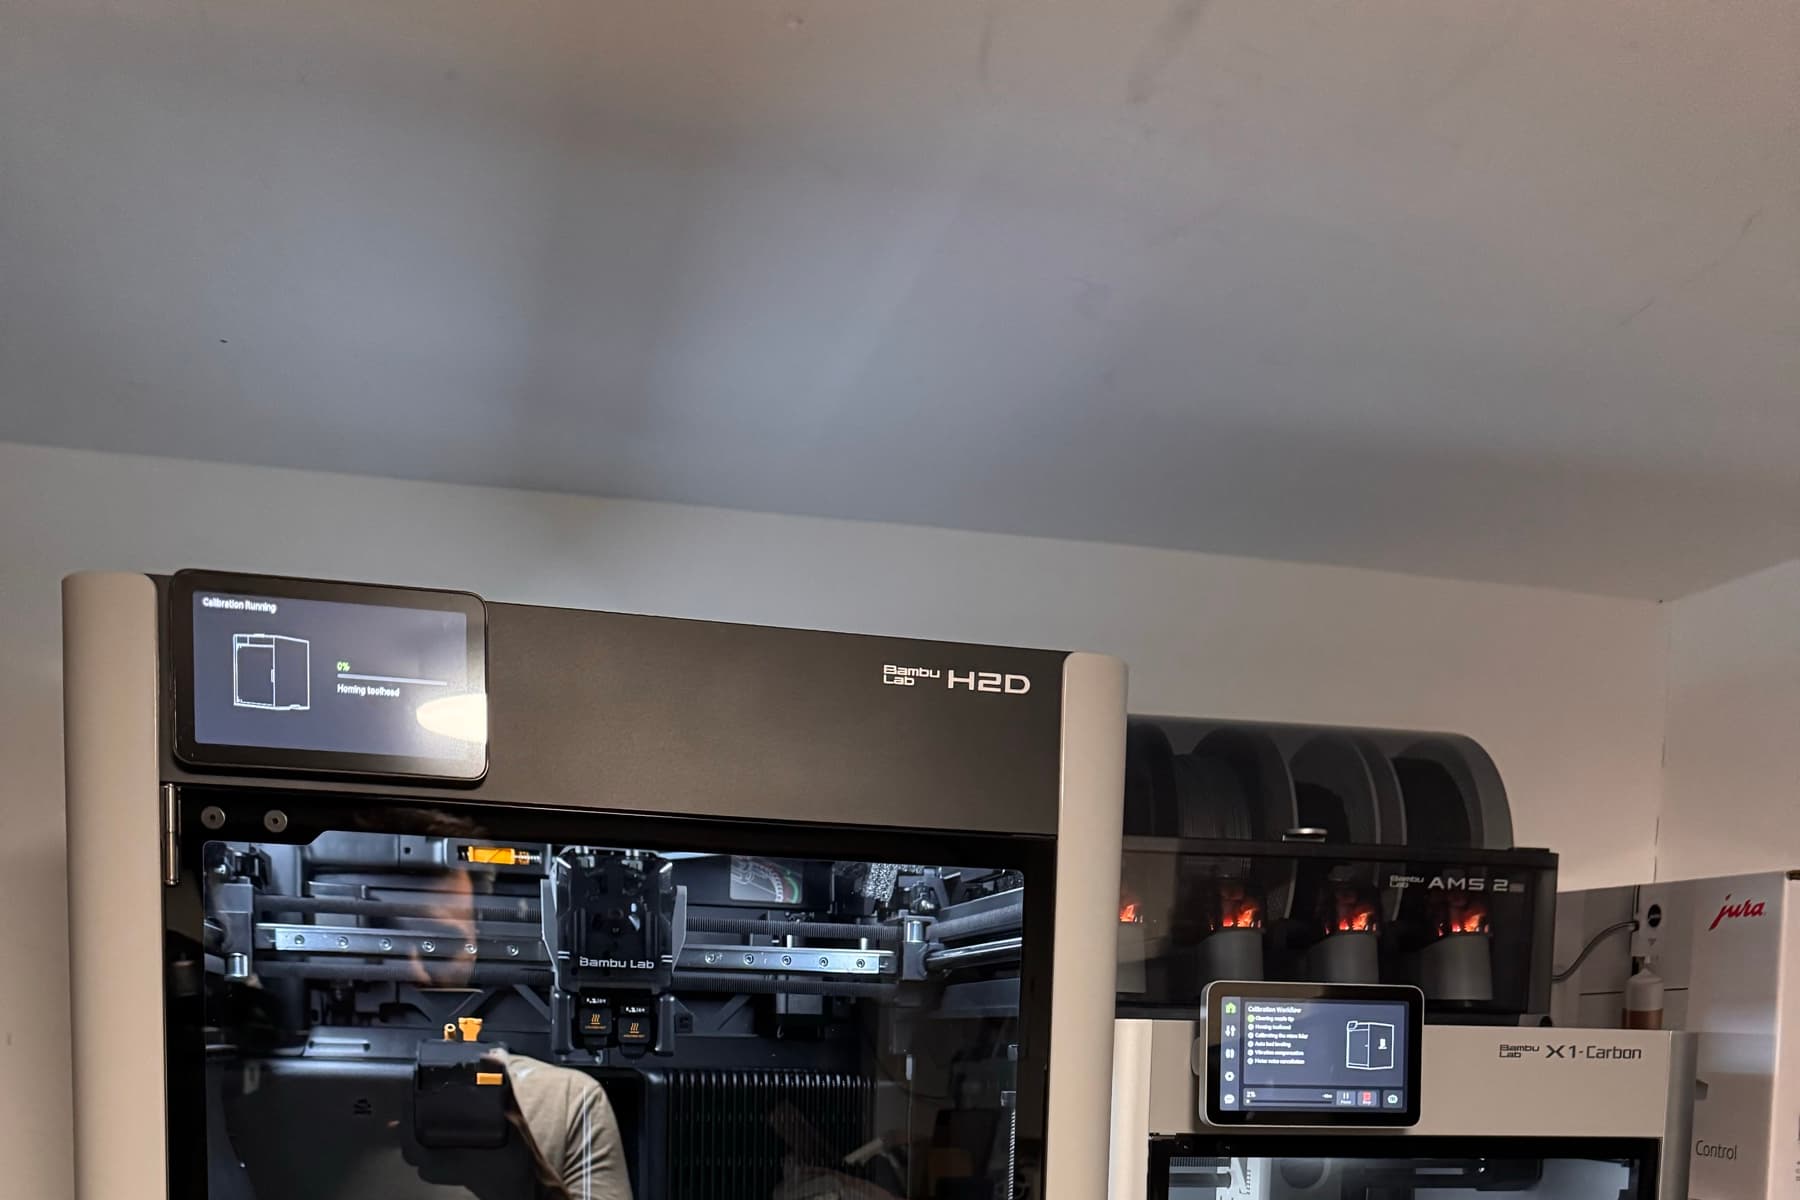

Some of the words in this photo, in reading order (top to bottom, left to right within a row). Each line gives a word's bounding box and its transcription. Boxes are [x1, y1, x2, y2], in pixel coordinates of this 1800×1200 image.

[202, 596, 244, 610] Calibration
[244, 600, 277, 615] Running
[336, 661, 351, 672] 0%
[883, 664, 940, 678] Bambu
[883, 675, 915, 686] Lab
[947, 669, 1031, 695] H2D
[337, 683, 366, 697] Homing
[367, 685, 400, 697] toolhead
[1390, 874, 1425, 883] Bambu
[1427, 876, 1486, 891] AMS
[1493, 879, 1508, 892] 2
[1708, 893, 1766, 932] jura
[579, 956, 627, 968] Bambu
[630, 960, 655, 969] Lab
[1499, 1044, 1540, 1052] Bambu
[1499, 1050, 1521, 1058] Lab
[1695, 1140, 1738, 1160] Control
